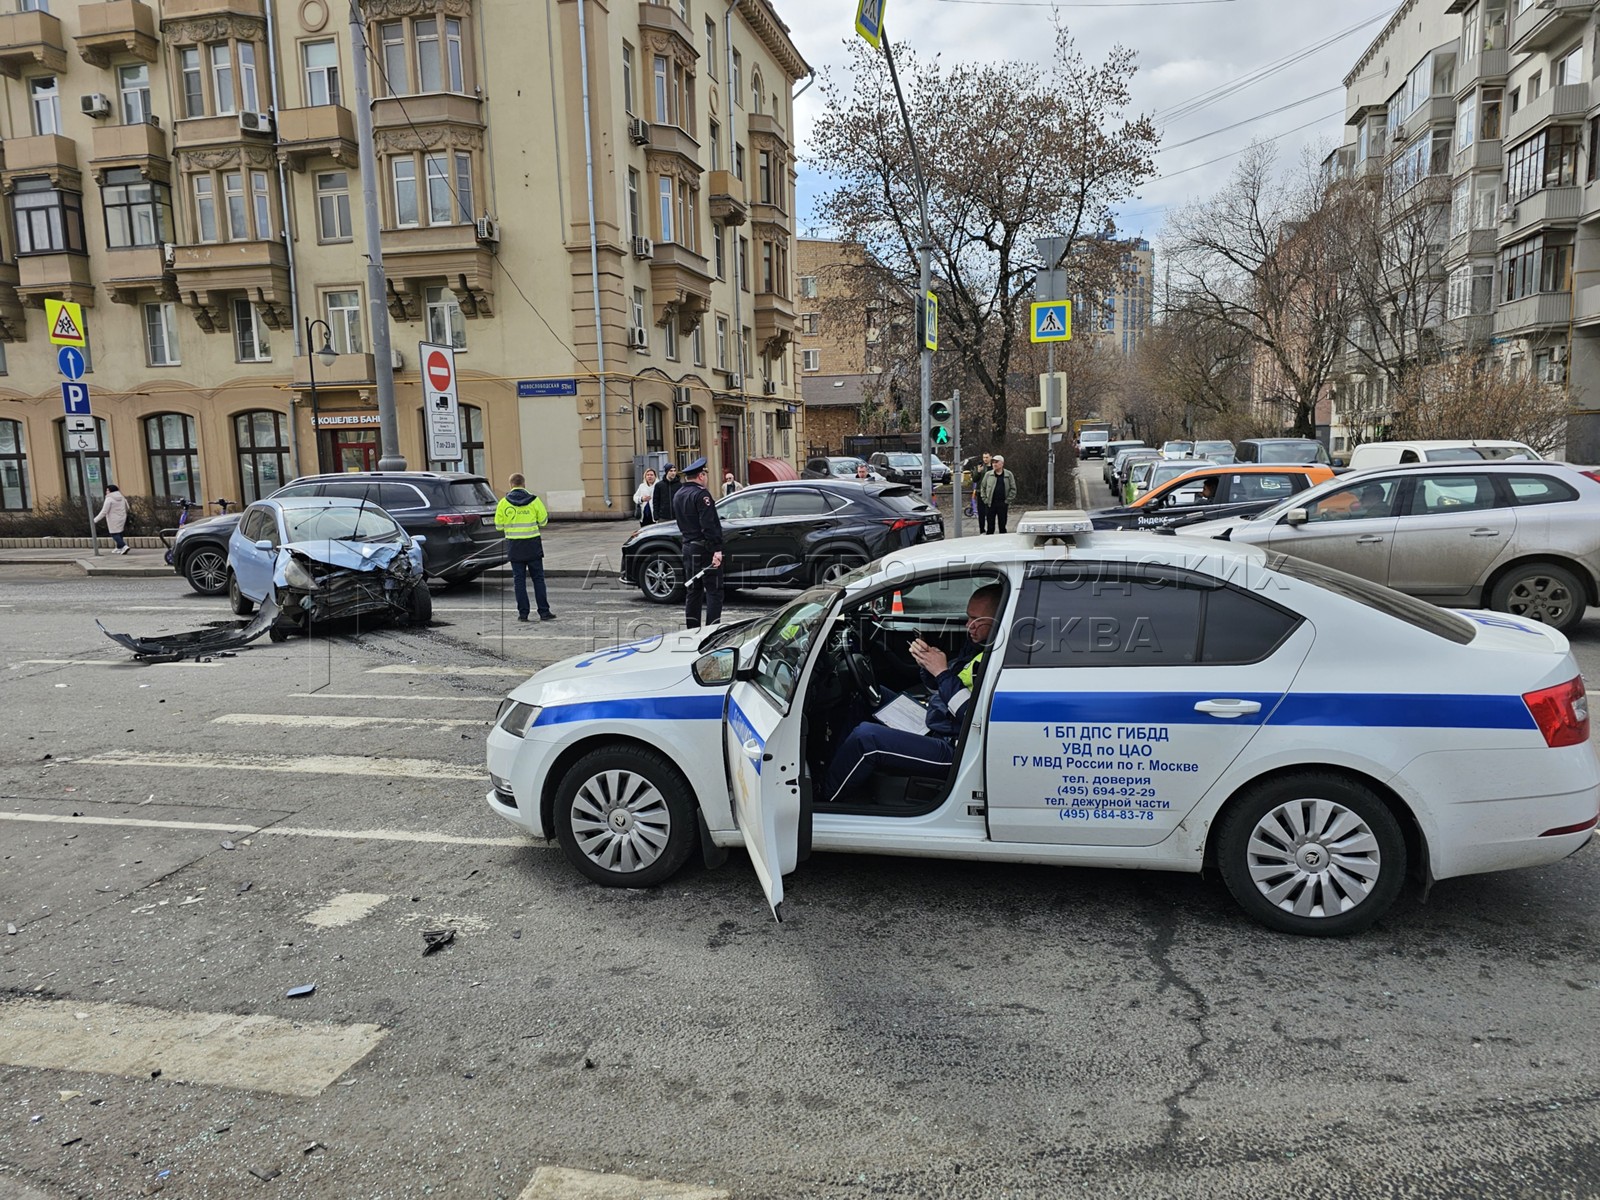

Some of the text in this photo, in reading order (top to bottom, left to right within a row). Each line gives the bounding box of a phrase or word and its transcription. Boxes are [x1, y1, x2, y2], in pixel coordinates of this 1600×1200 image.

[318, 416, 359, 425] КОШЕЛЕВ
[1043, 726, 1169, 742] 1 БП ДПС ГИБДД
[1062, 743, 1153, 758] УВД по ЦАО
[1013, 756, 1199, 772] ГУ МВД России по г. Москве
[1062, 775, 1151, 787] тел. доверия
[1057, 786, 1156, 797] (495) 694-92-29
[1045, 797, 1170, 809] тел. дежурной части
[1059, 809, 1154, 820] (495) 684-83-78
